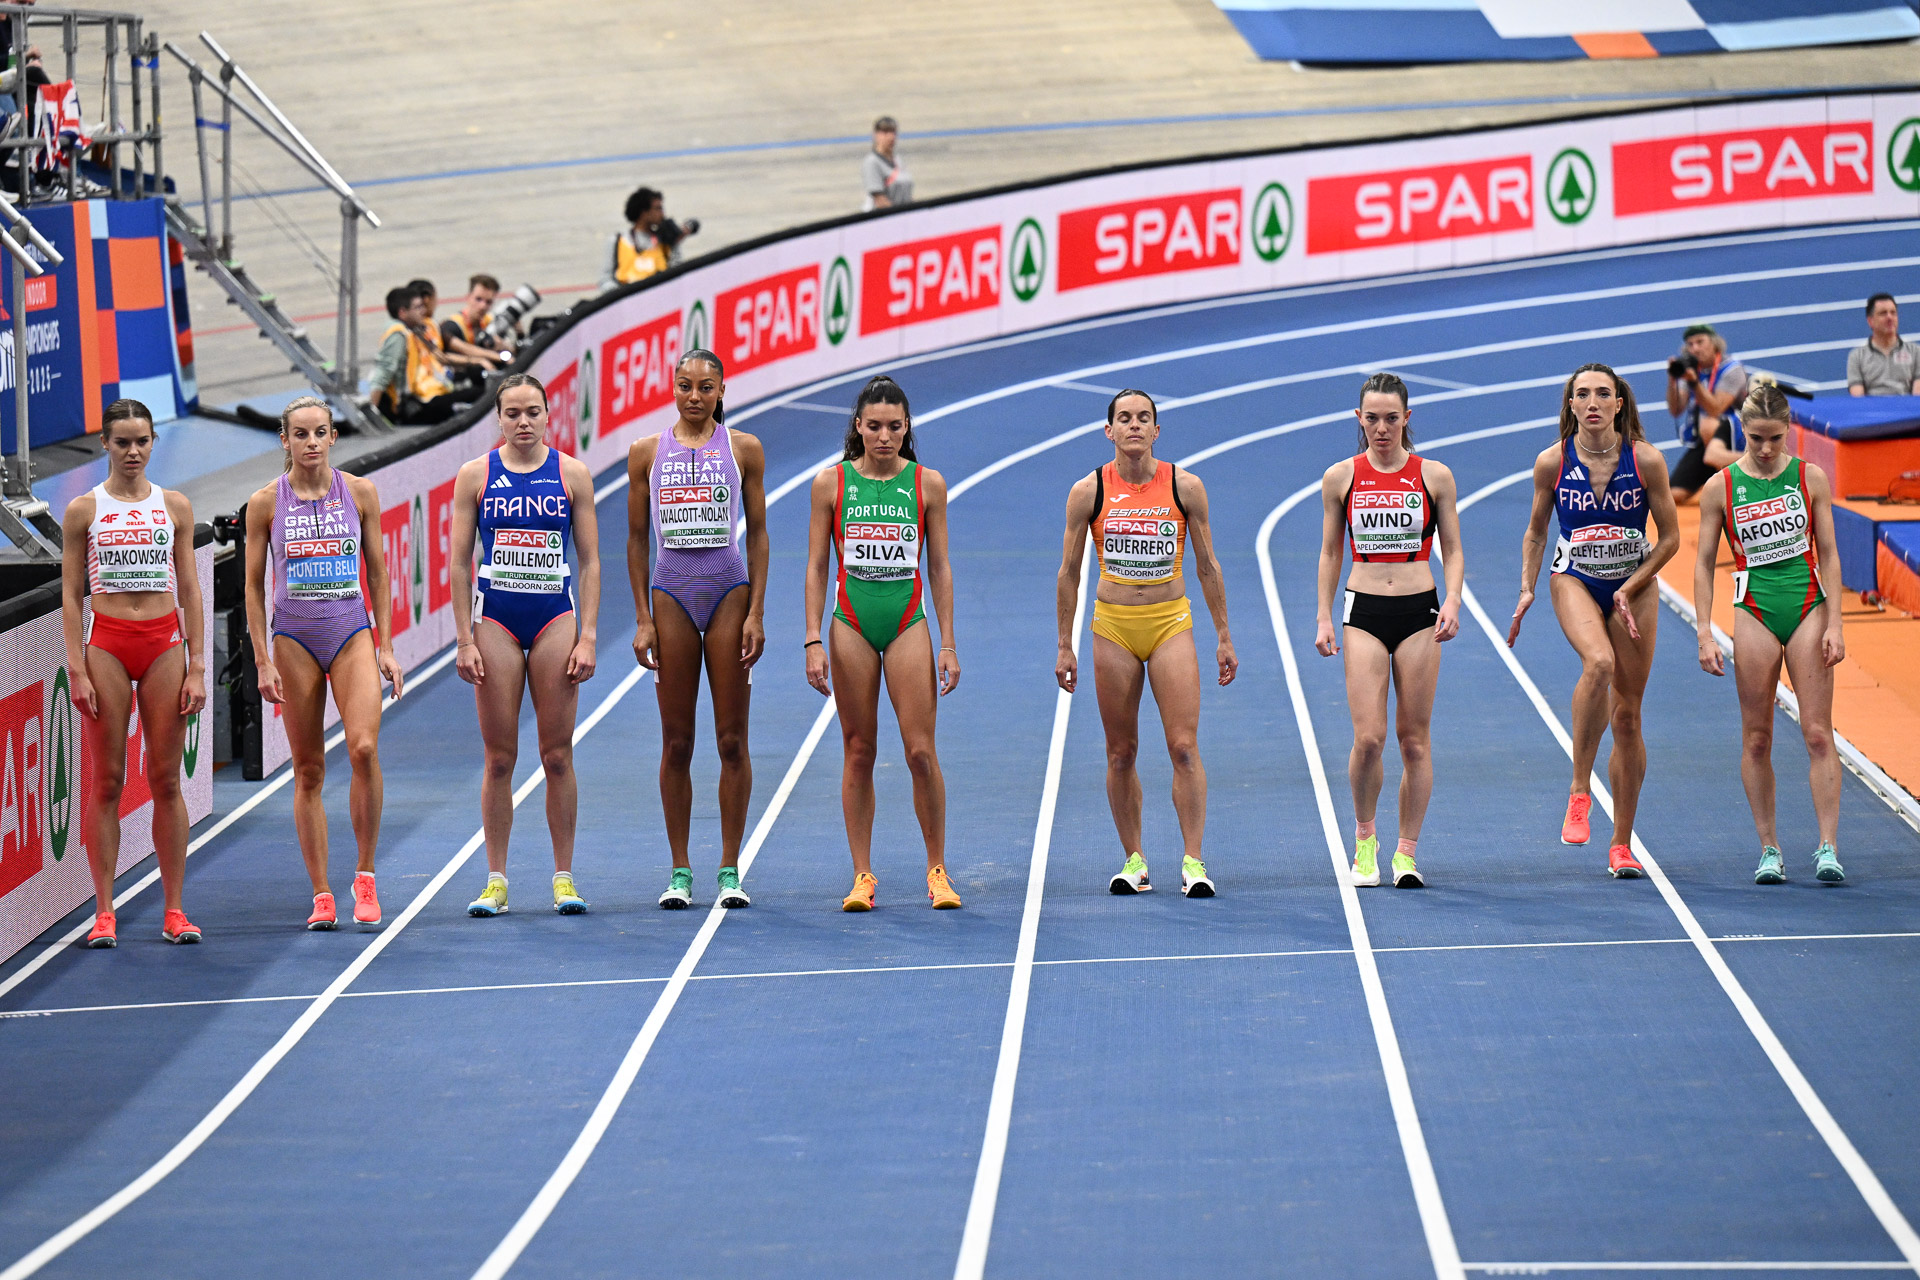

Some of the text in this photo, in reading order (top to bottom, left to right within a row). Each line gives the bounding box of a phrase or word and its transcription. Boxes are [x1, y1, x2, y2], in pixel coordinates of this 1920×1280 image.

[1671, 132, 1869, 199] SPAR
[1355, 166, 1530, 239] SPAR
[1095, 199, 1239, 274] SPAR
[888, 237, 999, 317] SPAR
[733, 278, 818, 363] SPAR
[612, 325, 680, 416] SPAR
[662, 460, 723, 473] GREAT
[661, 473, 726, 486] BRITAIN
[661, 489, 711, 503] SPAR
[1355, 494, 1403, 507] SPAR
[1559, 487, 1642, 511] FRANCE
[483, 495, 568, 519] FRANCE
[660, 506, 729, 524] WALCOTT-NOLAN
[847, 505, 911, 519] PORTUGAL
[1107, 507, 1171, 517] ESPAÑA
[1737, 501, 1785, 521] SPAR
[285, 510, 345, 527] GREAT
[1360, 512, 1413, 528] WIND
[286, 523, 350, 540] BRITAIN
[847, 525, 899, 539] SPAR
[1106, 521, 1158, 534] SPAR
[1573, 527, 1623, 540] SPAR
[1741, 514, 1806, 543] AFONSO
[100, 530, 150, 544] SPAR
[497, 532, 546, 546] SPAR
[288, 542, 340, 557] SPAR
[855, 544, 907, 561] SILVA
[1105, 538, 1175, 556] GUERRERO
[1357, 543, 1402, 551] APELDOORN
[1571, 542, 1640, 559] CLEYET-MERLE
[1749, 548, 1795, 563] APELDOORN
[99, 550, 167, 566] LIZAKOWSKA
[493, 550, 562, 569] GUILLEMOT
[1553, 547, 1562, 568] 2
[288, 559, 357, 578] HUNTER BELL
[1108, 565, 1155, 577] APELDOORN
[493, 580, 562, 591] APELDOORN 2025
[1736, 577, 1740, 599] 1
[0, 715, 41, 864] AR
